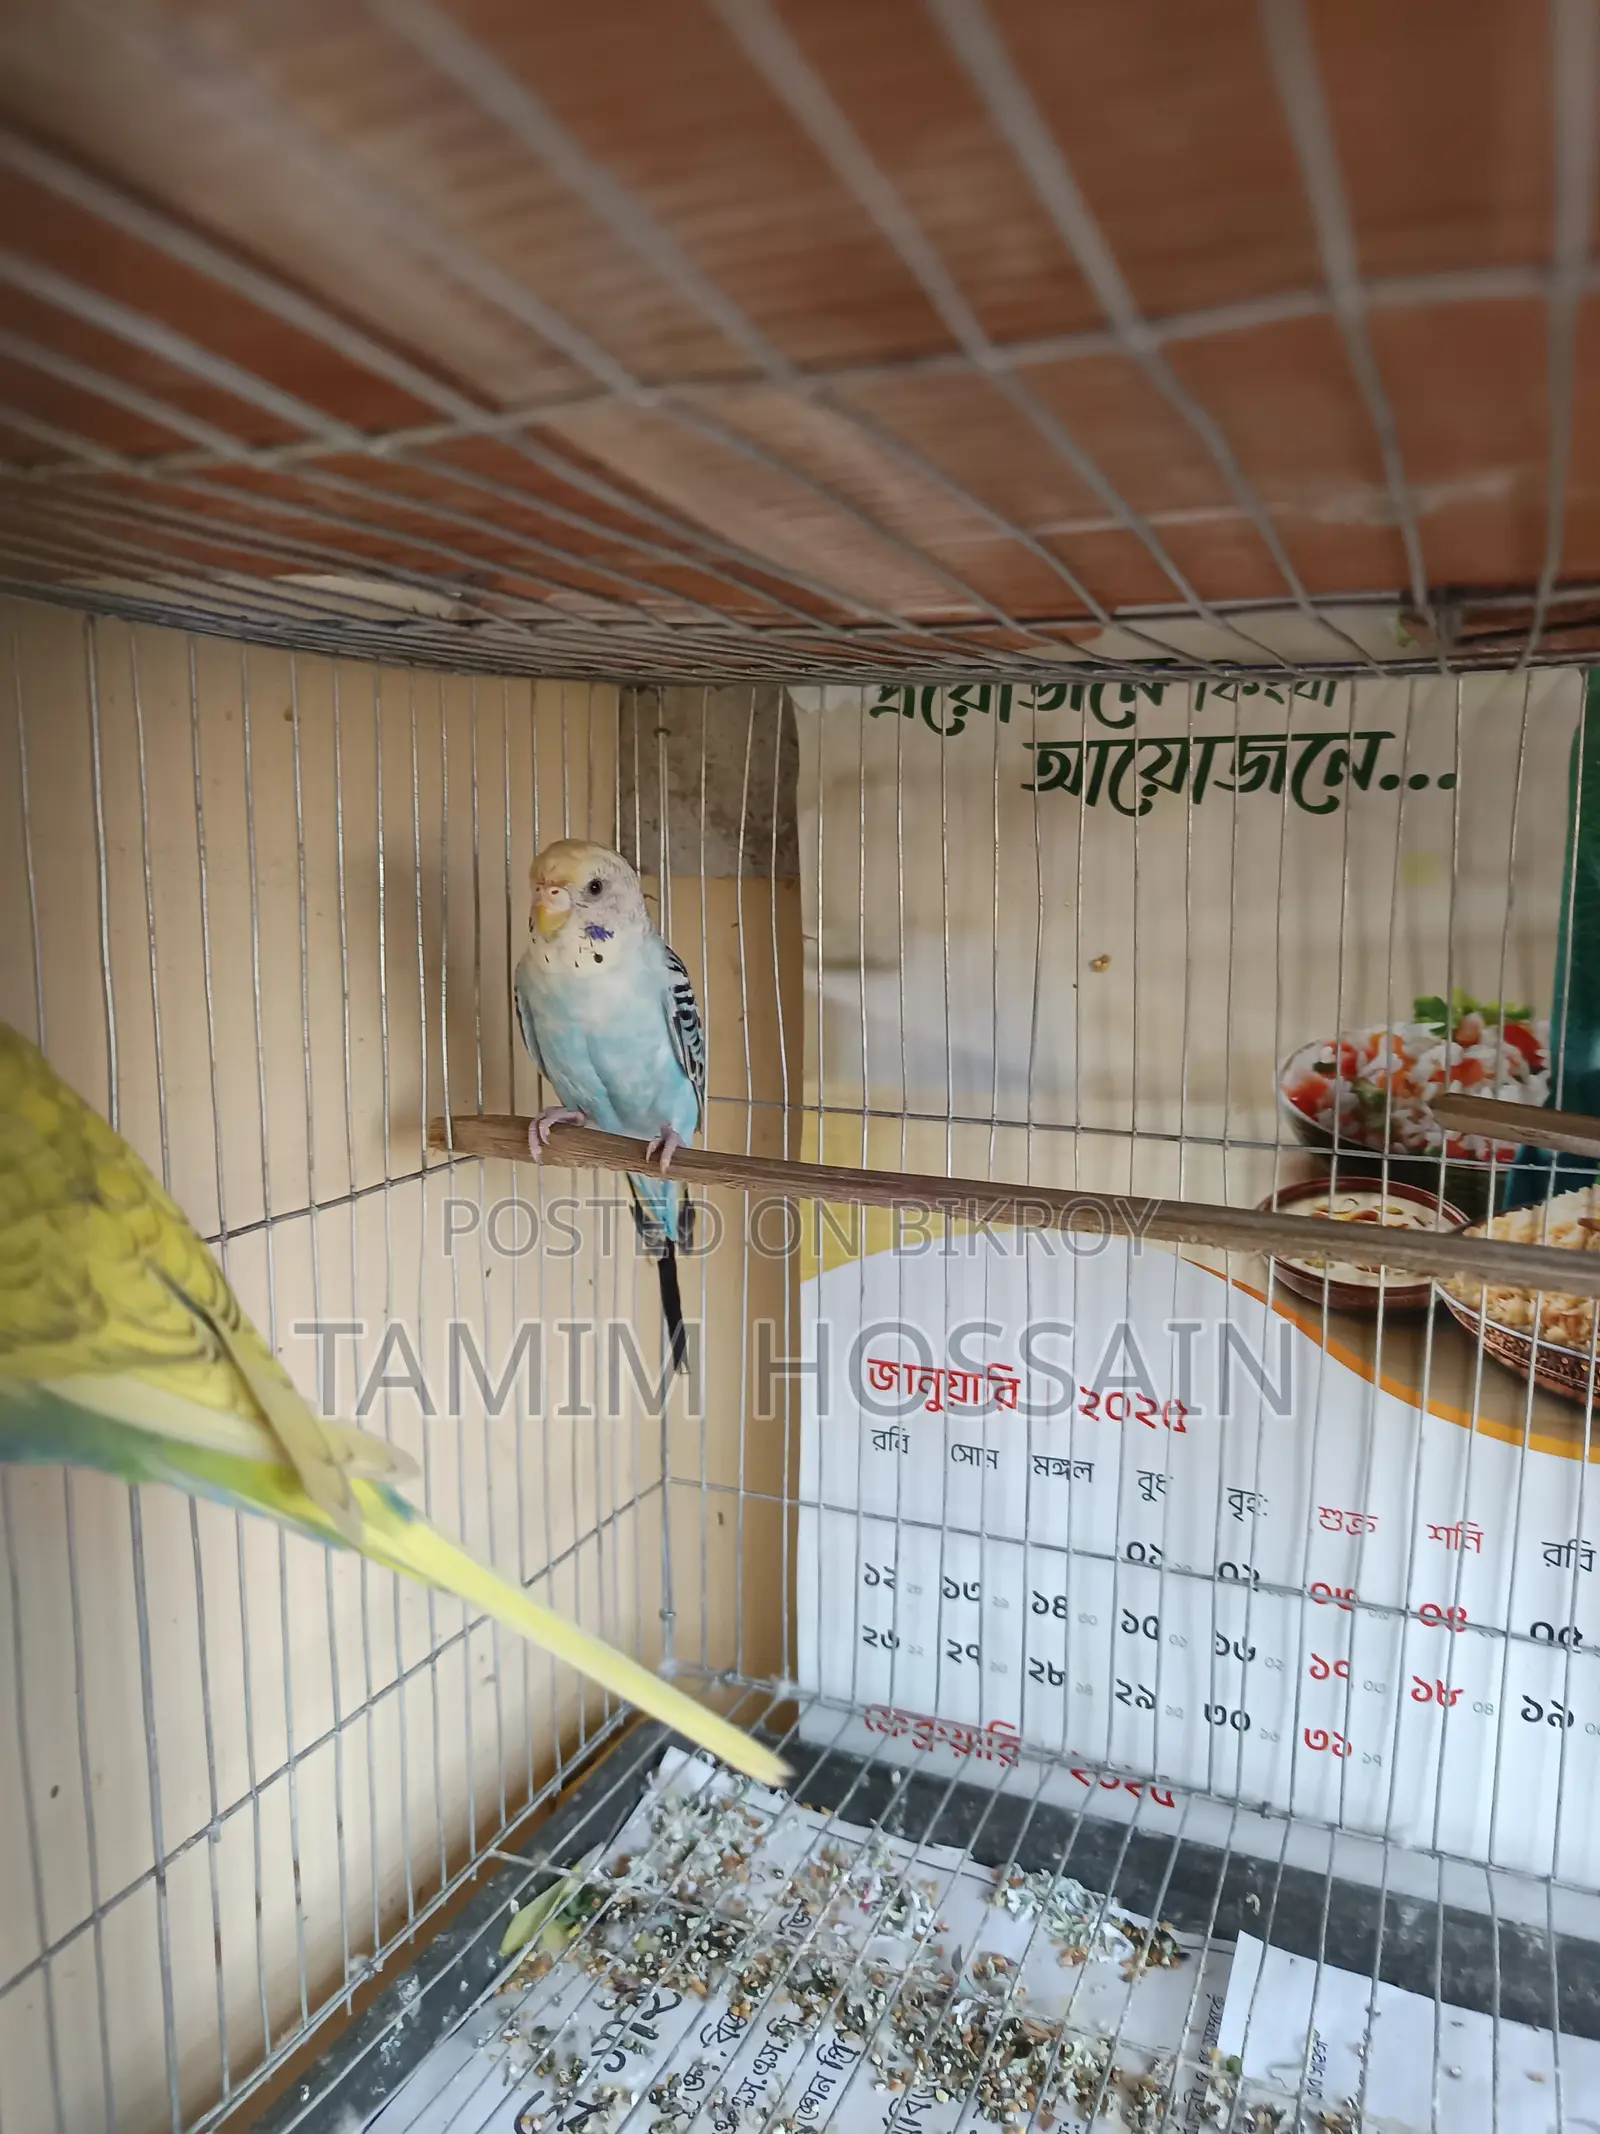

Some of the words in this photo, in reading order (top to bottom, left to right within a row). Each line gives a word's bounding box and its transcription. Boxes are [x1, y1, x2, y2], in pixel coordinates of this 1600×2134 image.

[867, 1358, 1021, 1412] জানুয়ারি
[1079, 1386, 1188, 1433] ২০২৫
[871, 1425, 910, 1454] রবি
[951, 1443, 999, 1470] সোম
[1032, 1455, 1095, 1482] মঙ্গল
[1318, 1505, 1379, 1536] শুক্র
[1427, 1521, 1485, 1553] শনি
[1541, 1538, 1597, 1572] রবি
[1411, 1674, 1465, 1709] ১৮
[1520, 1694, 1575, 1731] ১৯
